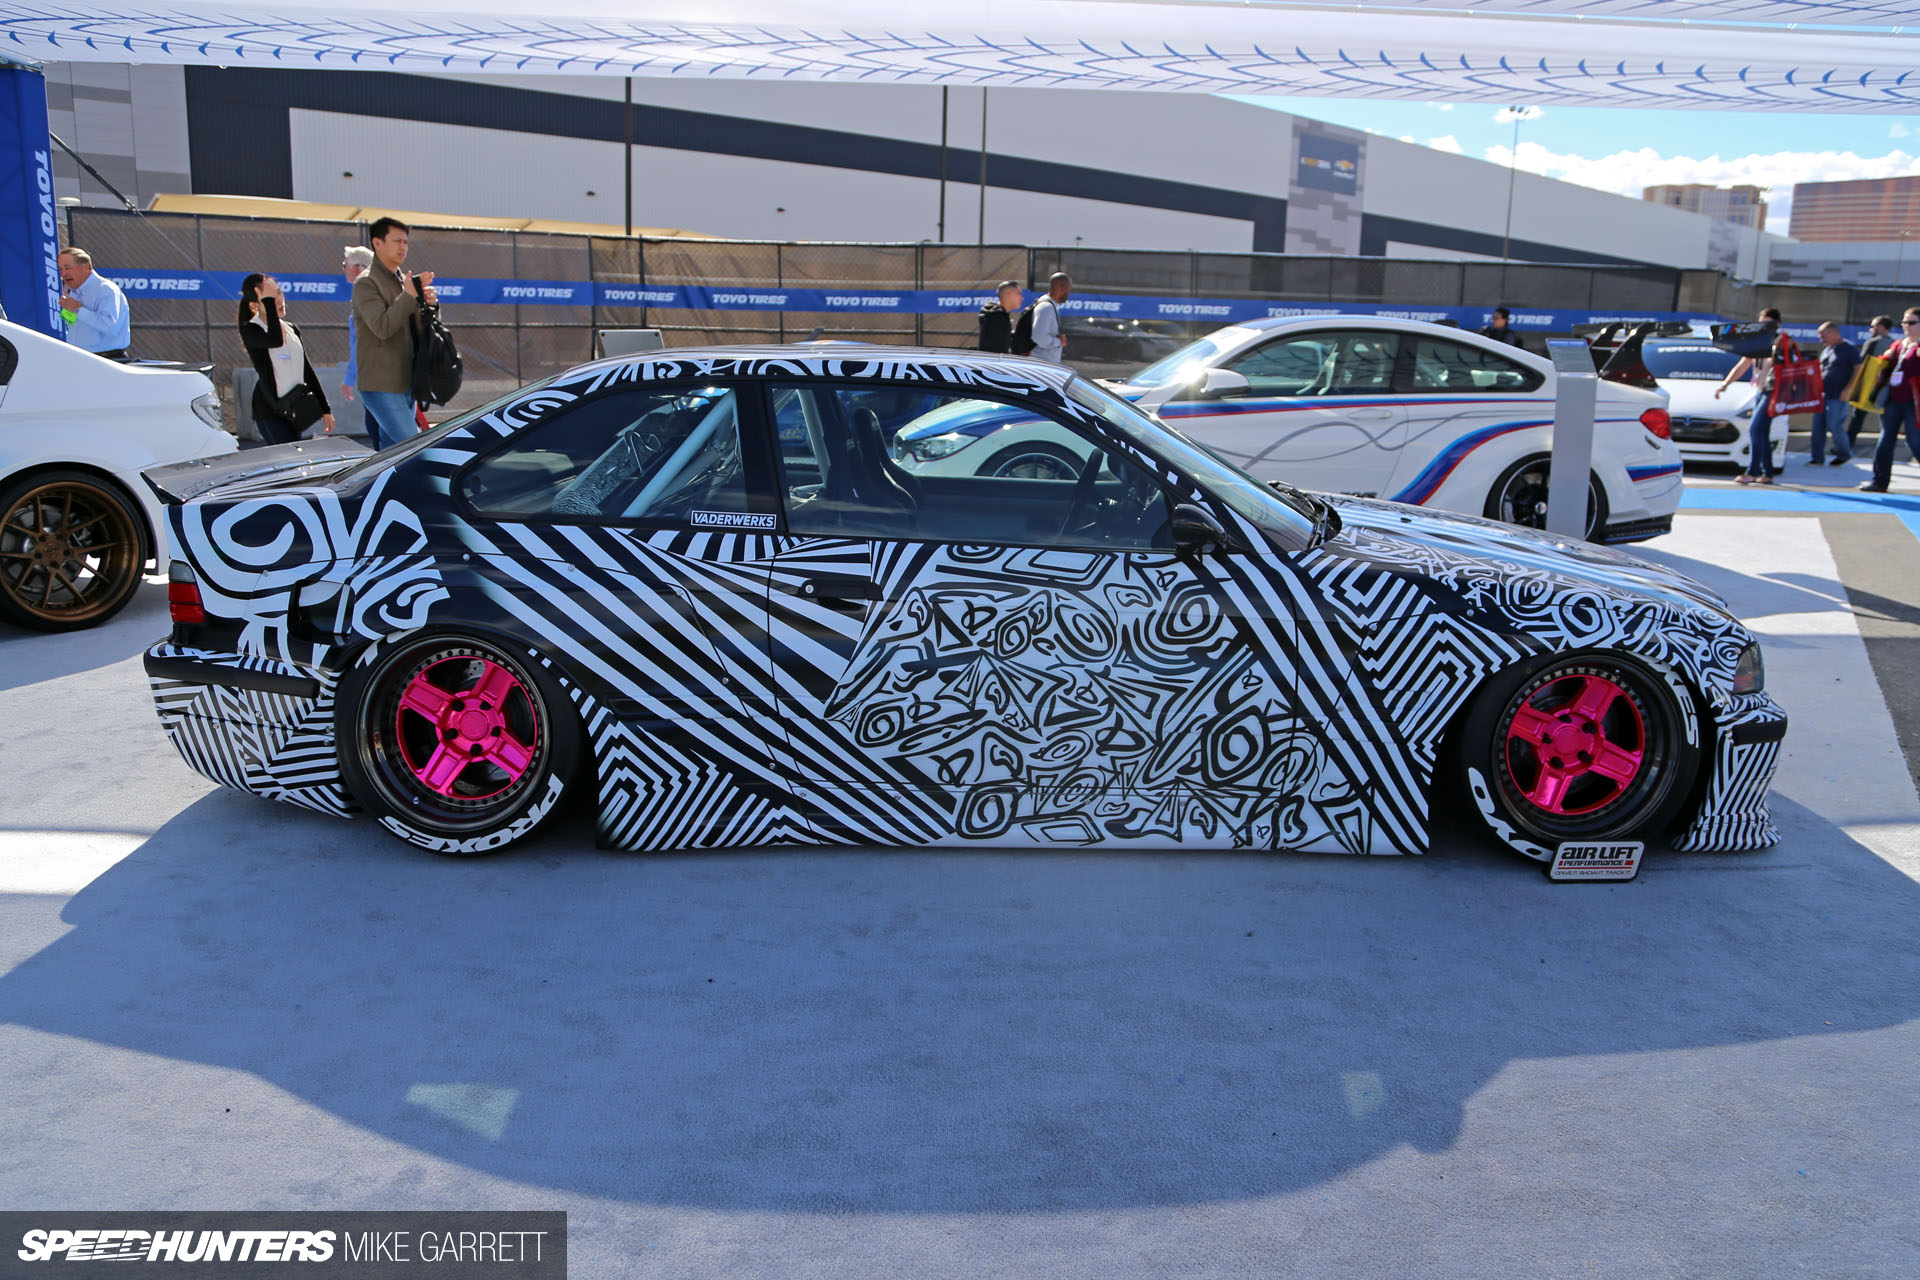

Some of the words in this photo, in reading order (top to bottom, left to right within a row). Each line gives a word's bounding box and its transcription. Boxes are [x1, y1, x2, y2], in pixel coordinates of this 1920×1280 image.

[35, 150, 55, 237] TOYO
[43, 240, 63, 332] TIRES
[112, 277, 148, 290] OYO
[150, 278, 201, 291] TIRES
[293, 282, 337, 294] TIRES
[503, 286, 537, 298] TOYO
[538, 287, 573, 299] TIRES
[604, 289, 636, 300] TOYO
[637, 291, 675, 302] TIRES
[712, 293, 750, 304] TOYO
[750, 294, 787, 305] TIRES
[825, 296, 860, 306] TOYO
[862, 296, 899, 307] TIRES
[937, 296, 972, 307] TOYO
[1083, 301, 1121, 311] TIRES
[1158, 303, 1193, 315] TOYO
[1194, 305, 1232, 316] TIRES
[1517, 315, 1554, 325] TIRES
[694, 513, 774, 527] VADERWERKS
[378, 773, 565, 853] PROXES
[1599, 847, 1639, 859] LIFT
